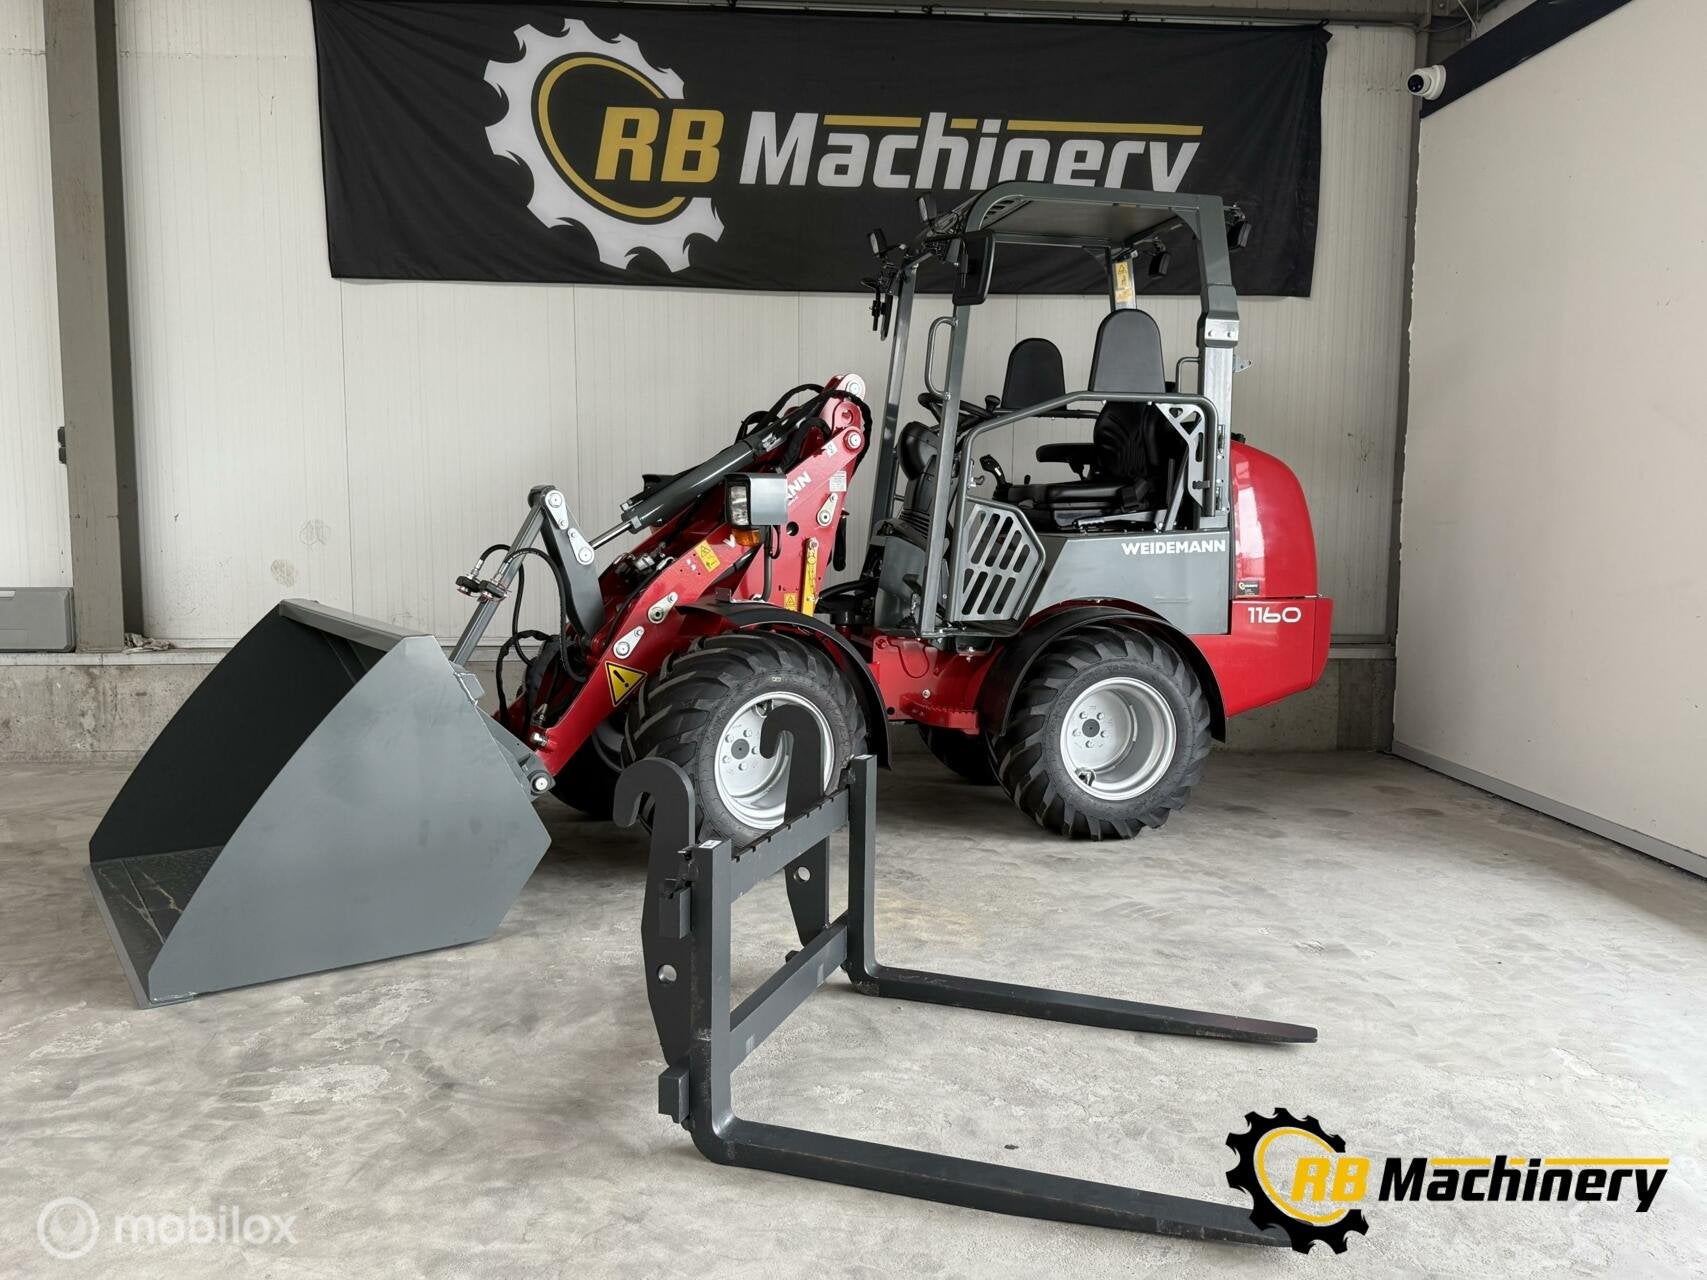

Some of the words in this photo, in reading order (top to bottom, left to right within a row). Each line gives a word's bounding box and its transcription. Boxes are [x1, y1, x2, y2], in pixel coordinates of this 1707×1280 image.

[594, 106, 725, 183] RB
[739, 111, 1201, 193] Machinery
[1121, 539, 1226, 555] WEIDEMANN
[1248, 607, 1302, 624] 1160
